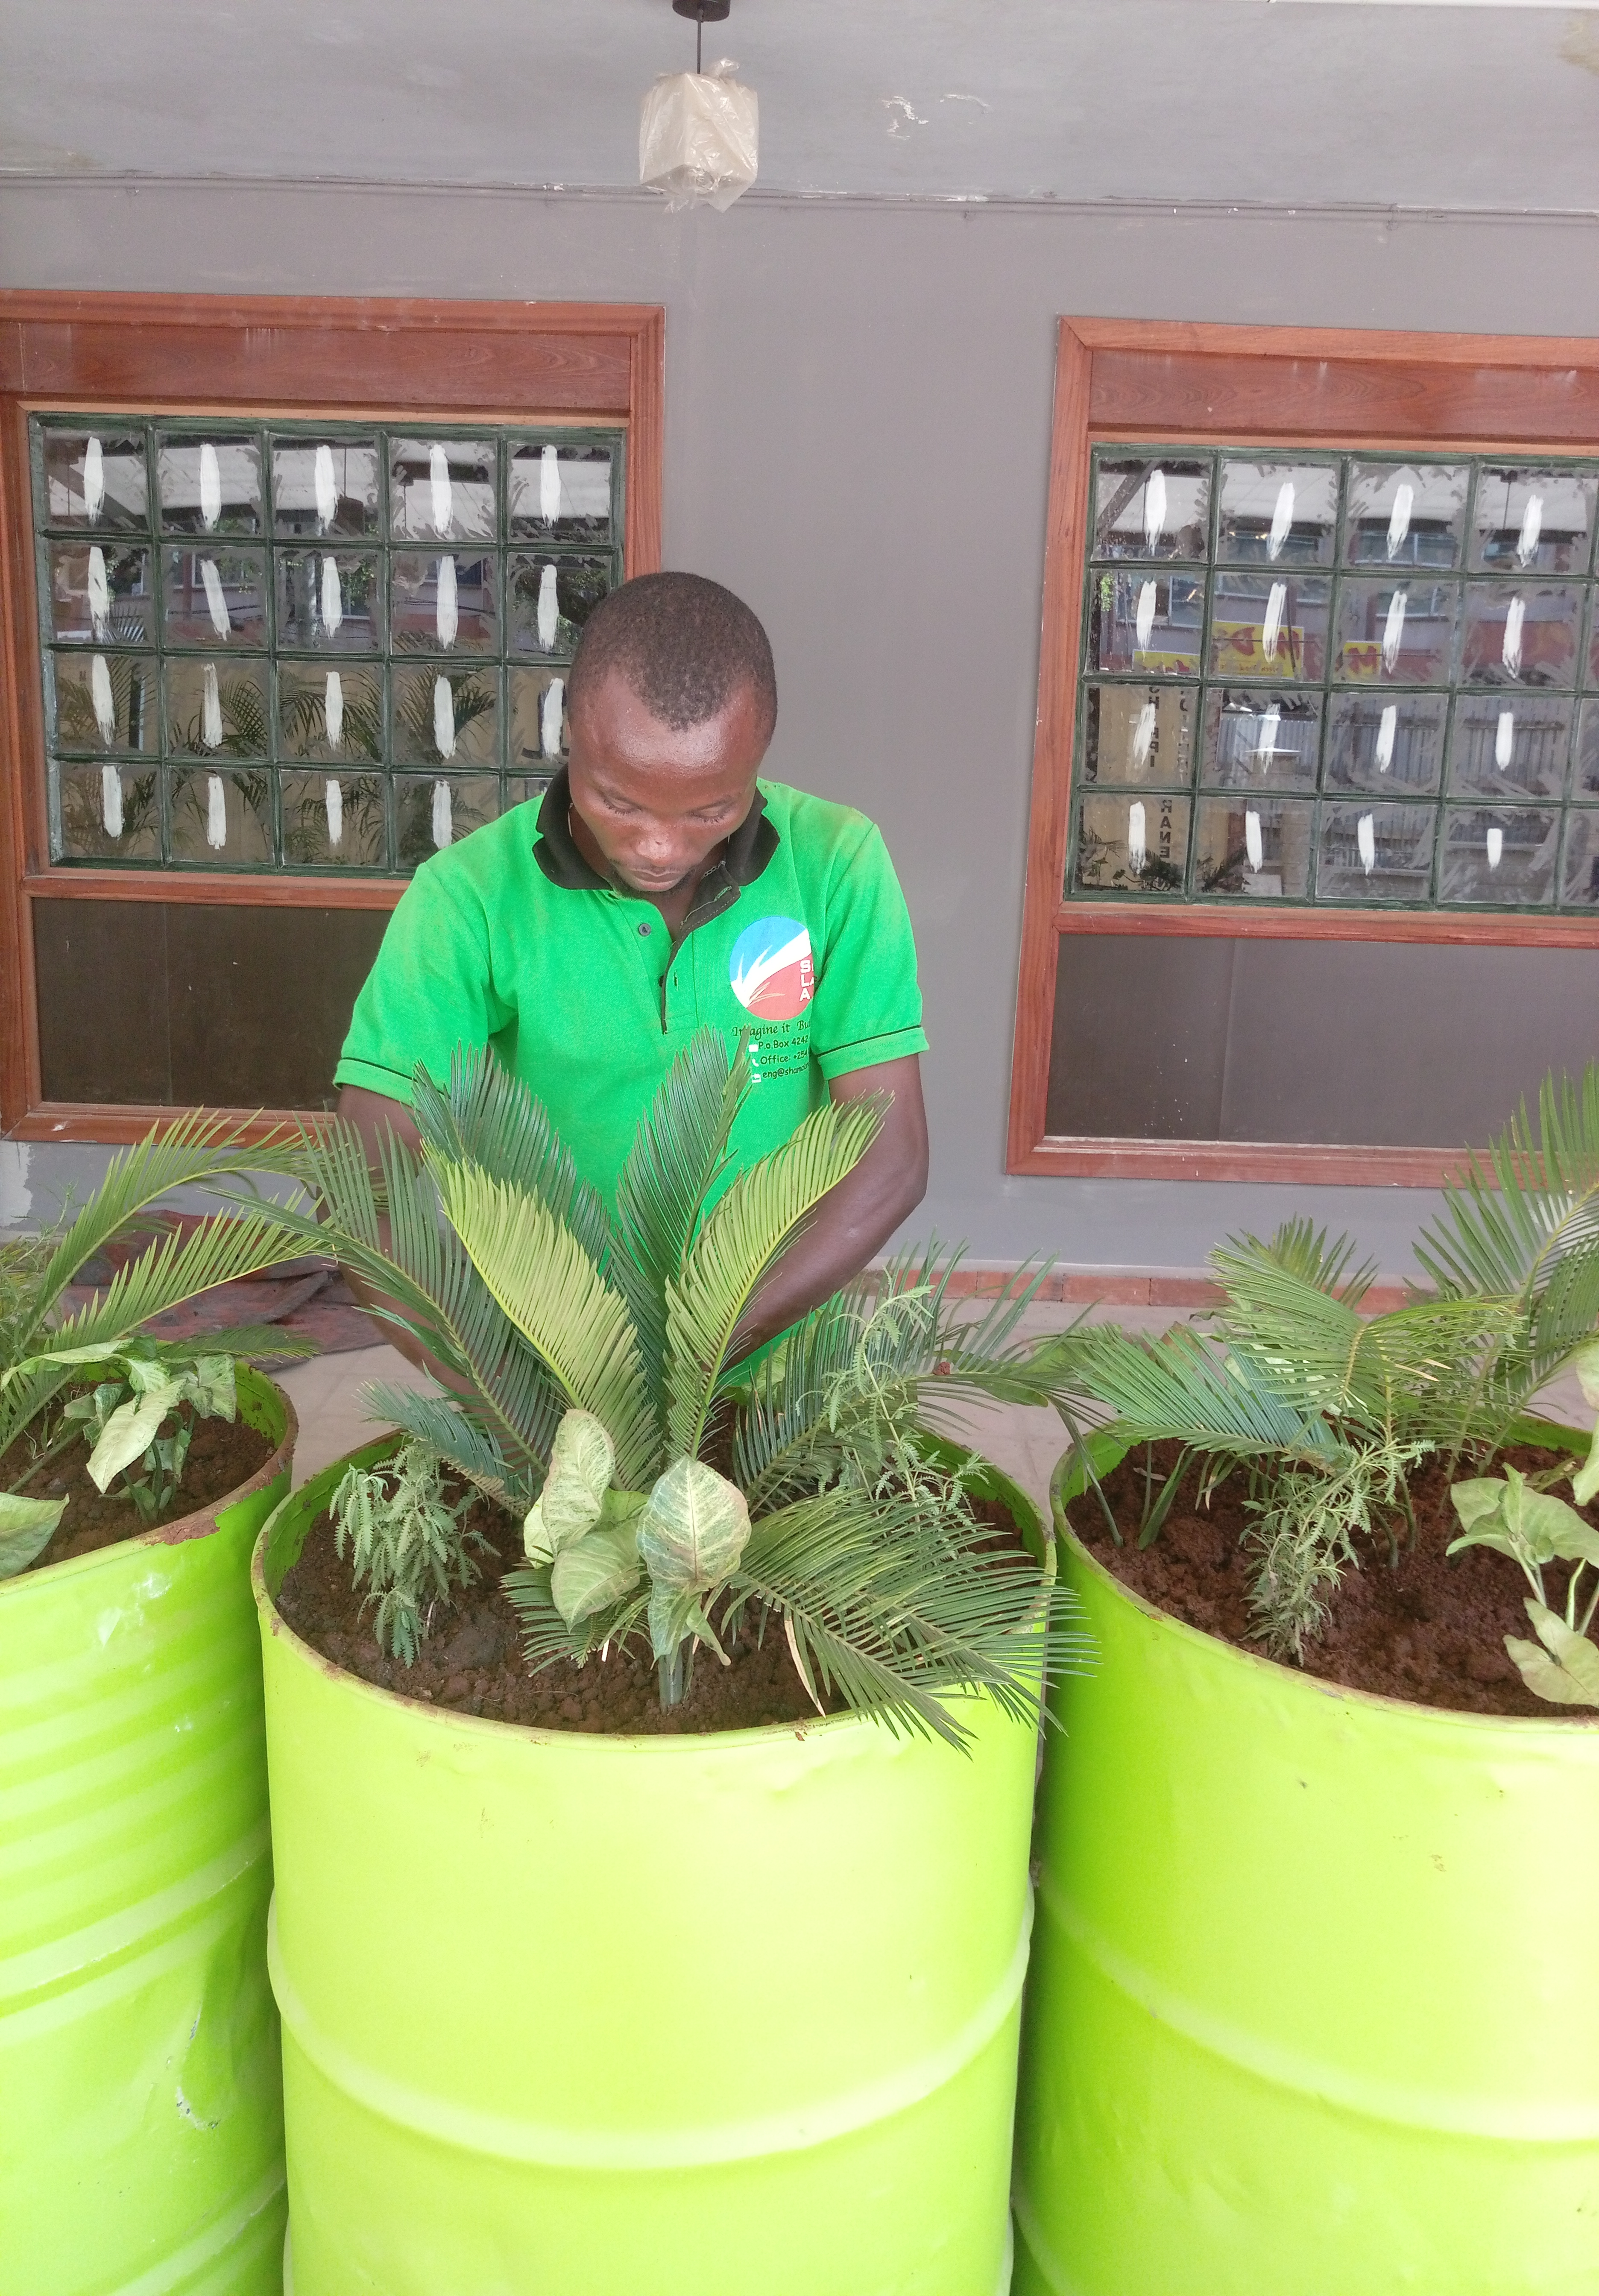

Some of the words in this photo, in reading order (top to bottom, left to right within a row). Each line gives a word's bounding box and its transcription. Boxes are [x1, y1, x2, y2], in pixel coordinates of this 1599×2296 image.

[782, 1022, 790, 1033] it
[773, 1040, 789, 1048] Box
[791, 1035, 808, 1045] 4242
[761, 1054, 791, 1065] Office:
